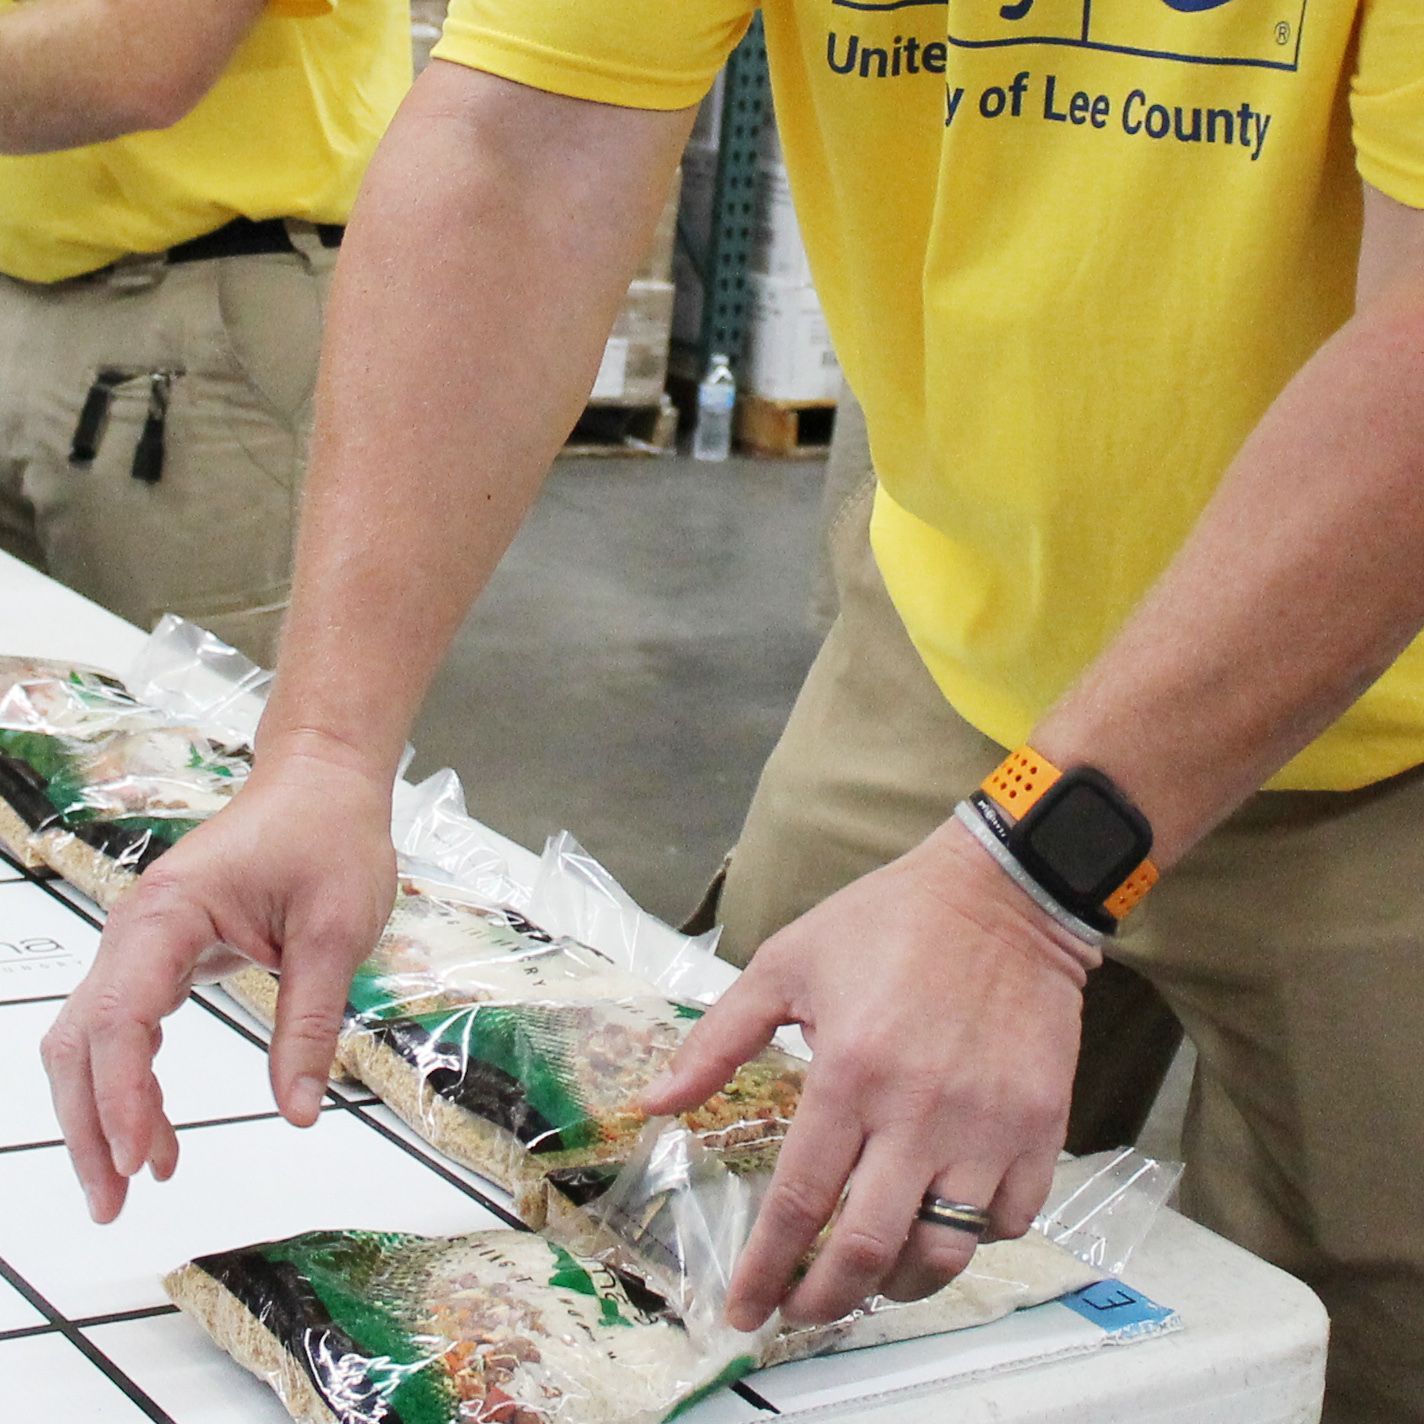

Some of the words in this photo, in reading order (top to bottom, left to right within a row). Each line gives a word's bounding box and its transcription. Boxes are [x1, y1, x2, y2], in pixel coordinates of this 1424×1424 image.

[827, 31, 947, 78] Unite
[979, 71, 1029, 118] of
[1044, 75, 1110, 129] Lee
[1121, 88, 1271, 161] County
